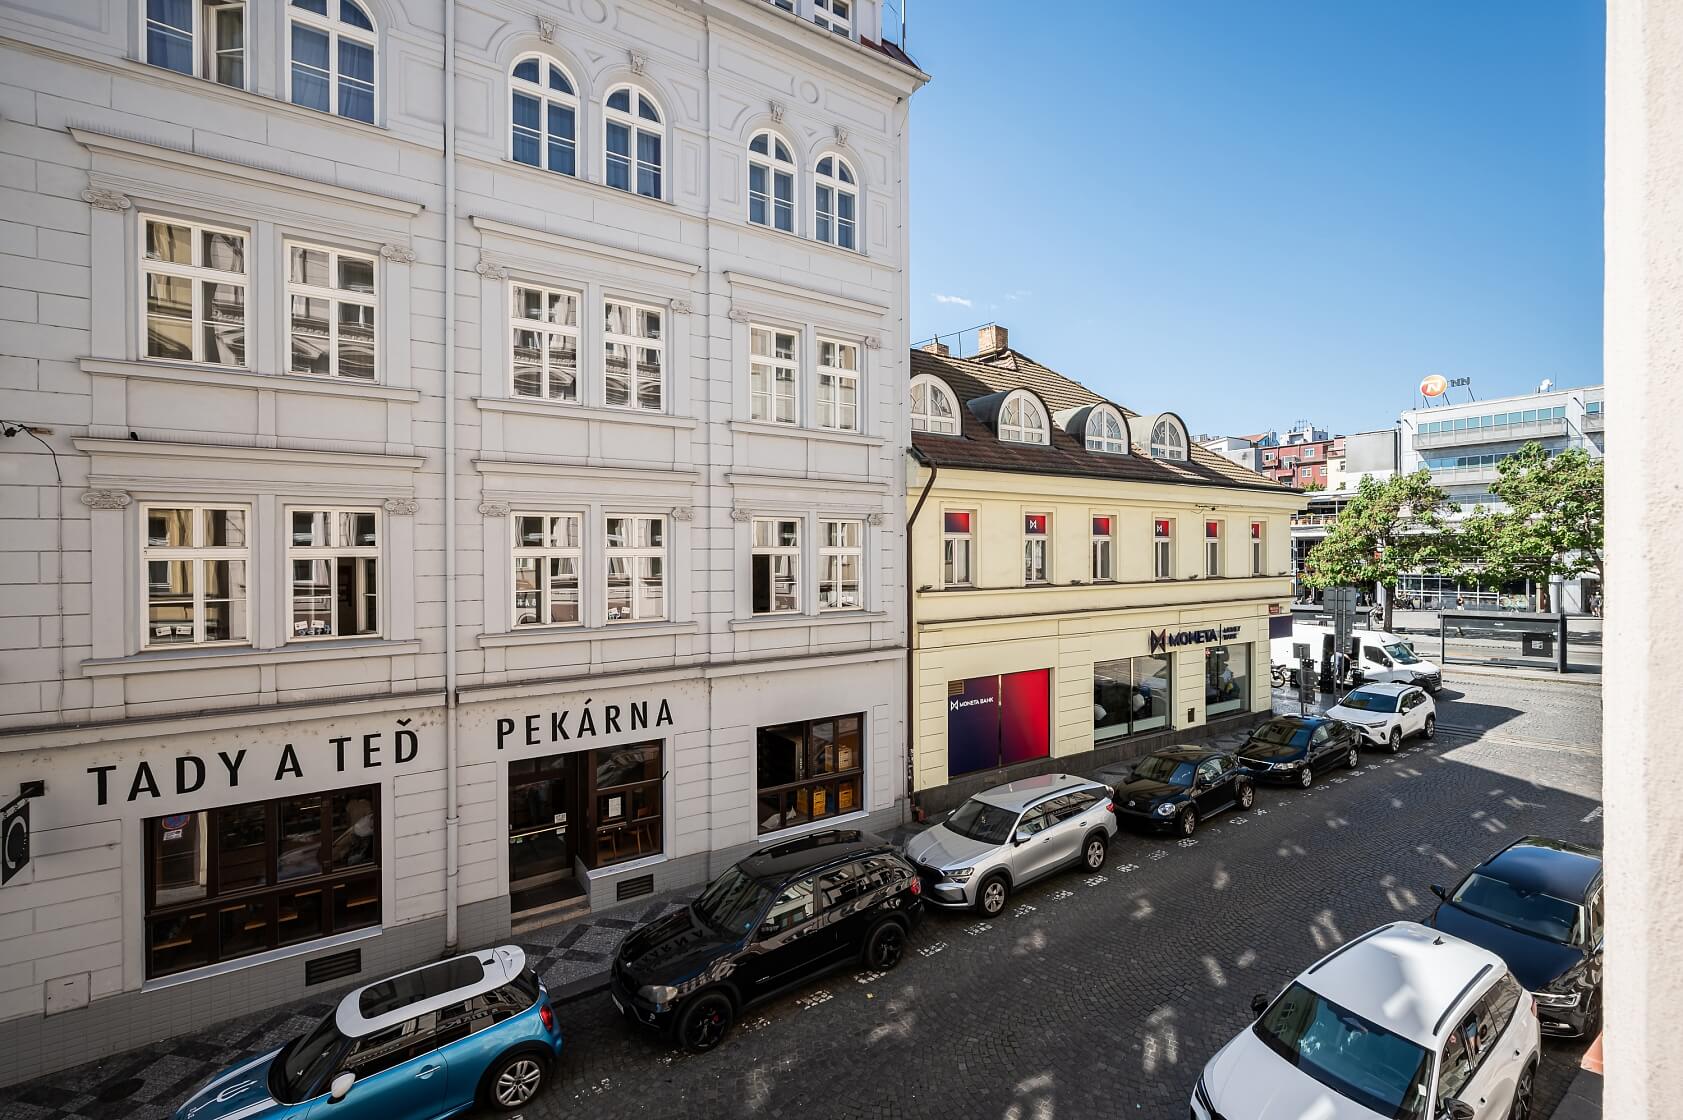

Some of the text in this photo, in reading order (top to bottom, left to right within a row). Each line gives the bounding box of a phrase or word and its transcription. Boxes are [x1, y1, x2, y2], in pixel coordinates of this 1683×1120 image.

[1168, 628, 1218, 647] MONETA
[959, 699, 980, 708] MONETA
[496, 697, 674, 750] PEKÁRNA
[86, 717, 419, 806] TADY A TEĎ
